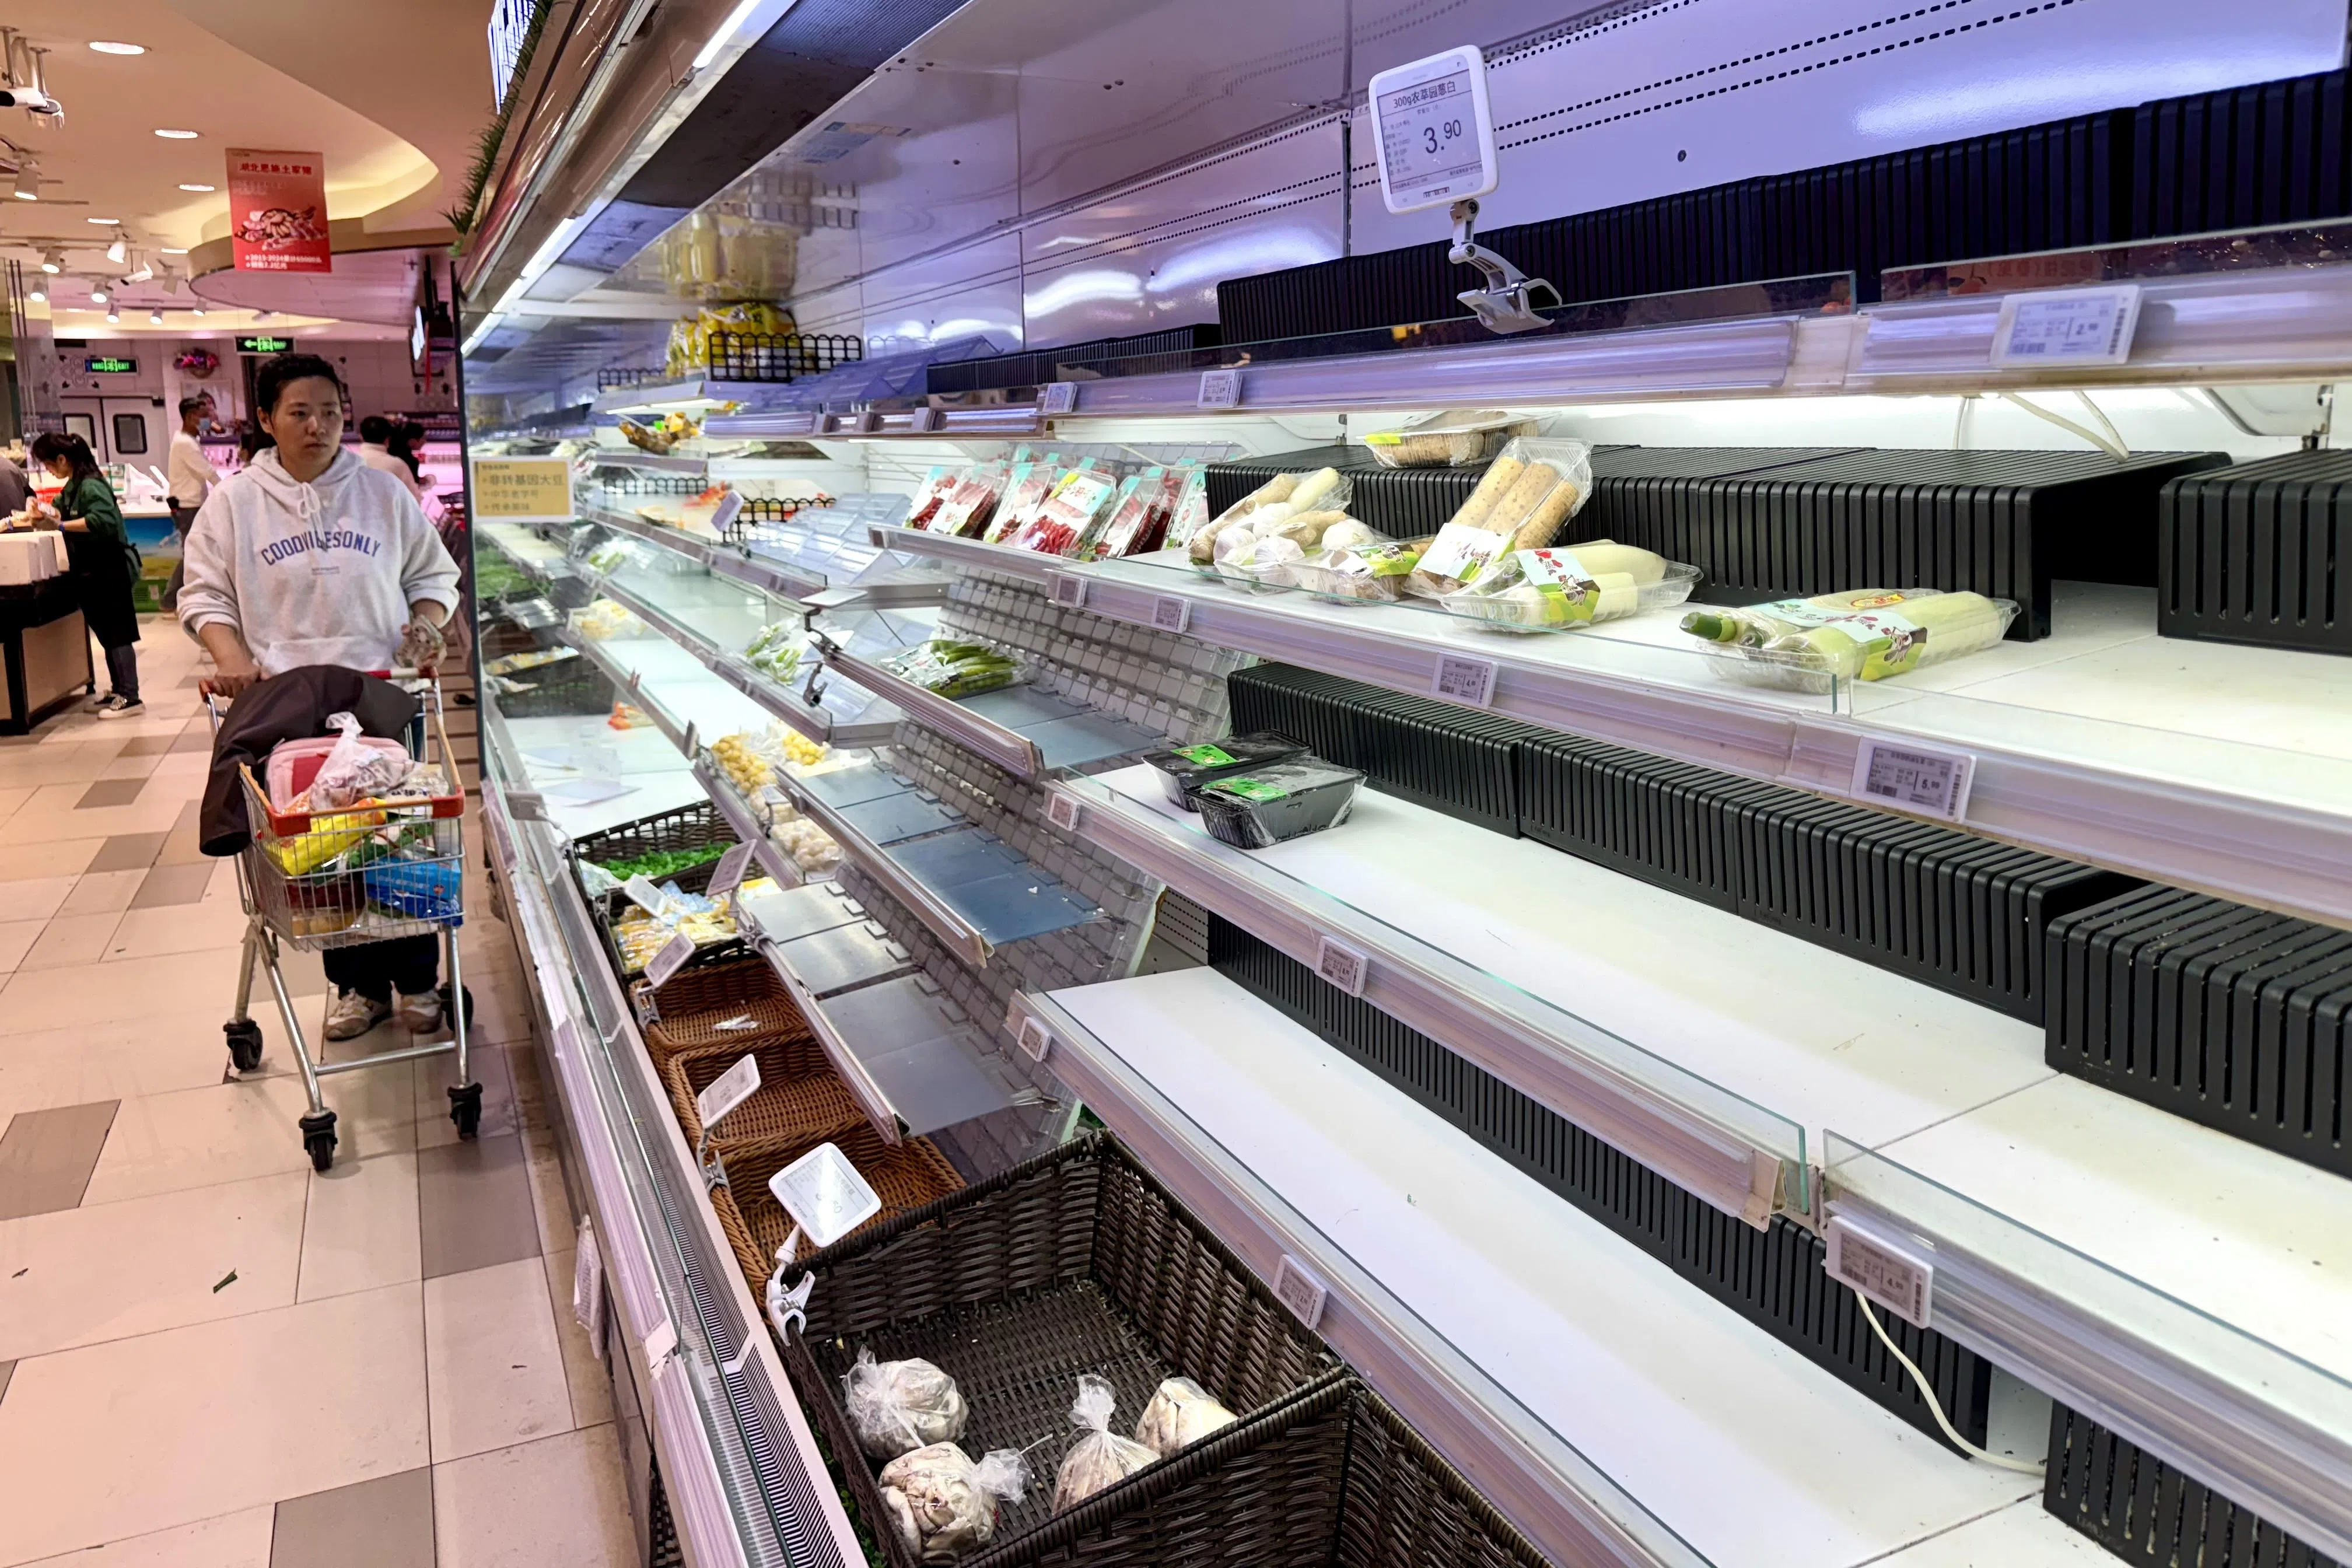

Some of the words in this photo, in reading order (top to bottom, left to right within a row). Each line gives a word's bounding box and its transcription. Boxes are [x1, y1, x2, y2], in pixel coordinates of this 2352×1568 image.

[1393, 80, 1456, 109] 300g农萃园葱白
[1423, 119, 1462, 154] 3.90
[489, 474, 564, 486] 非转基因大豆
